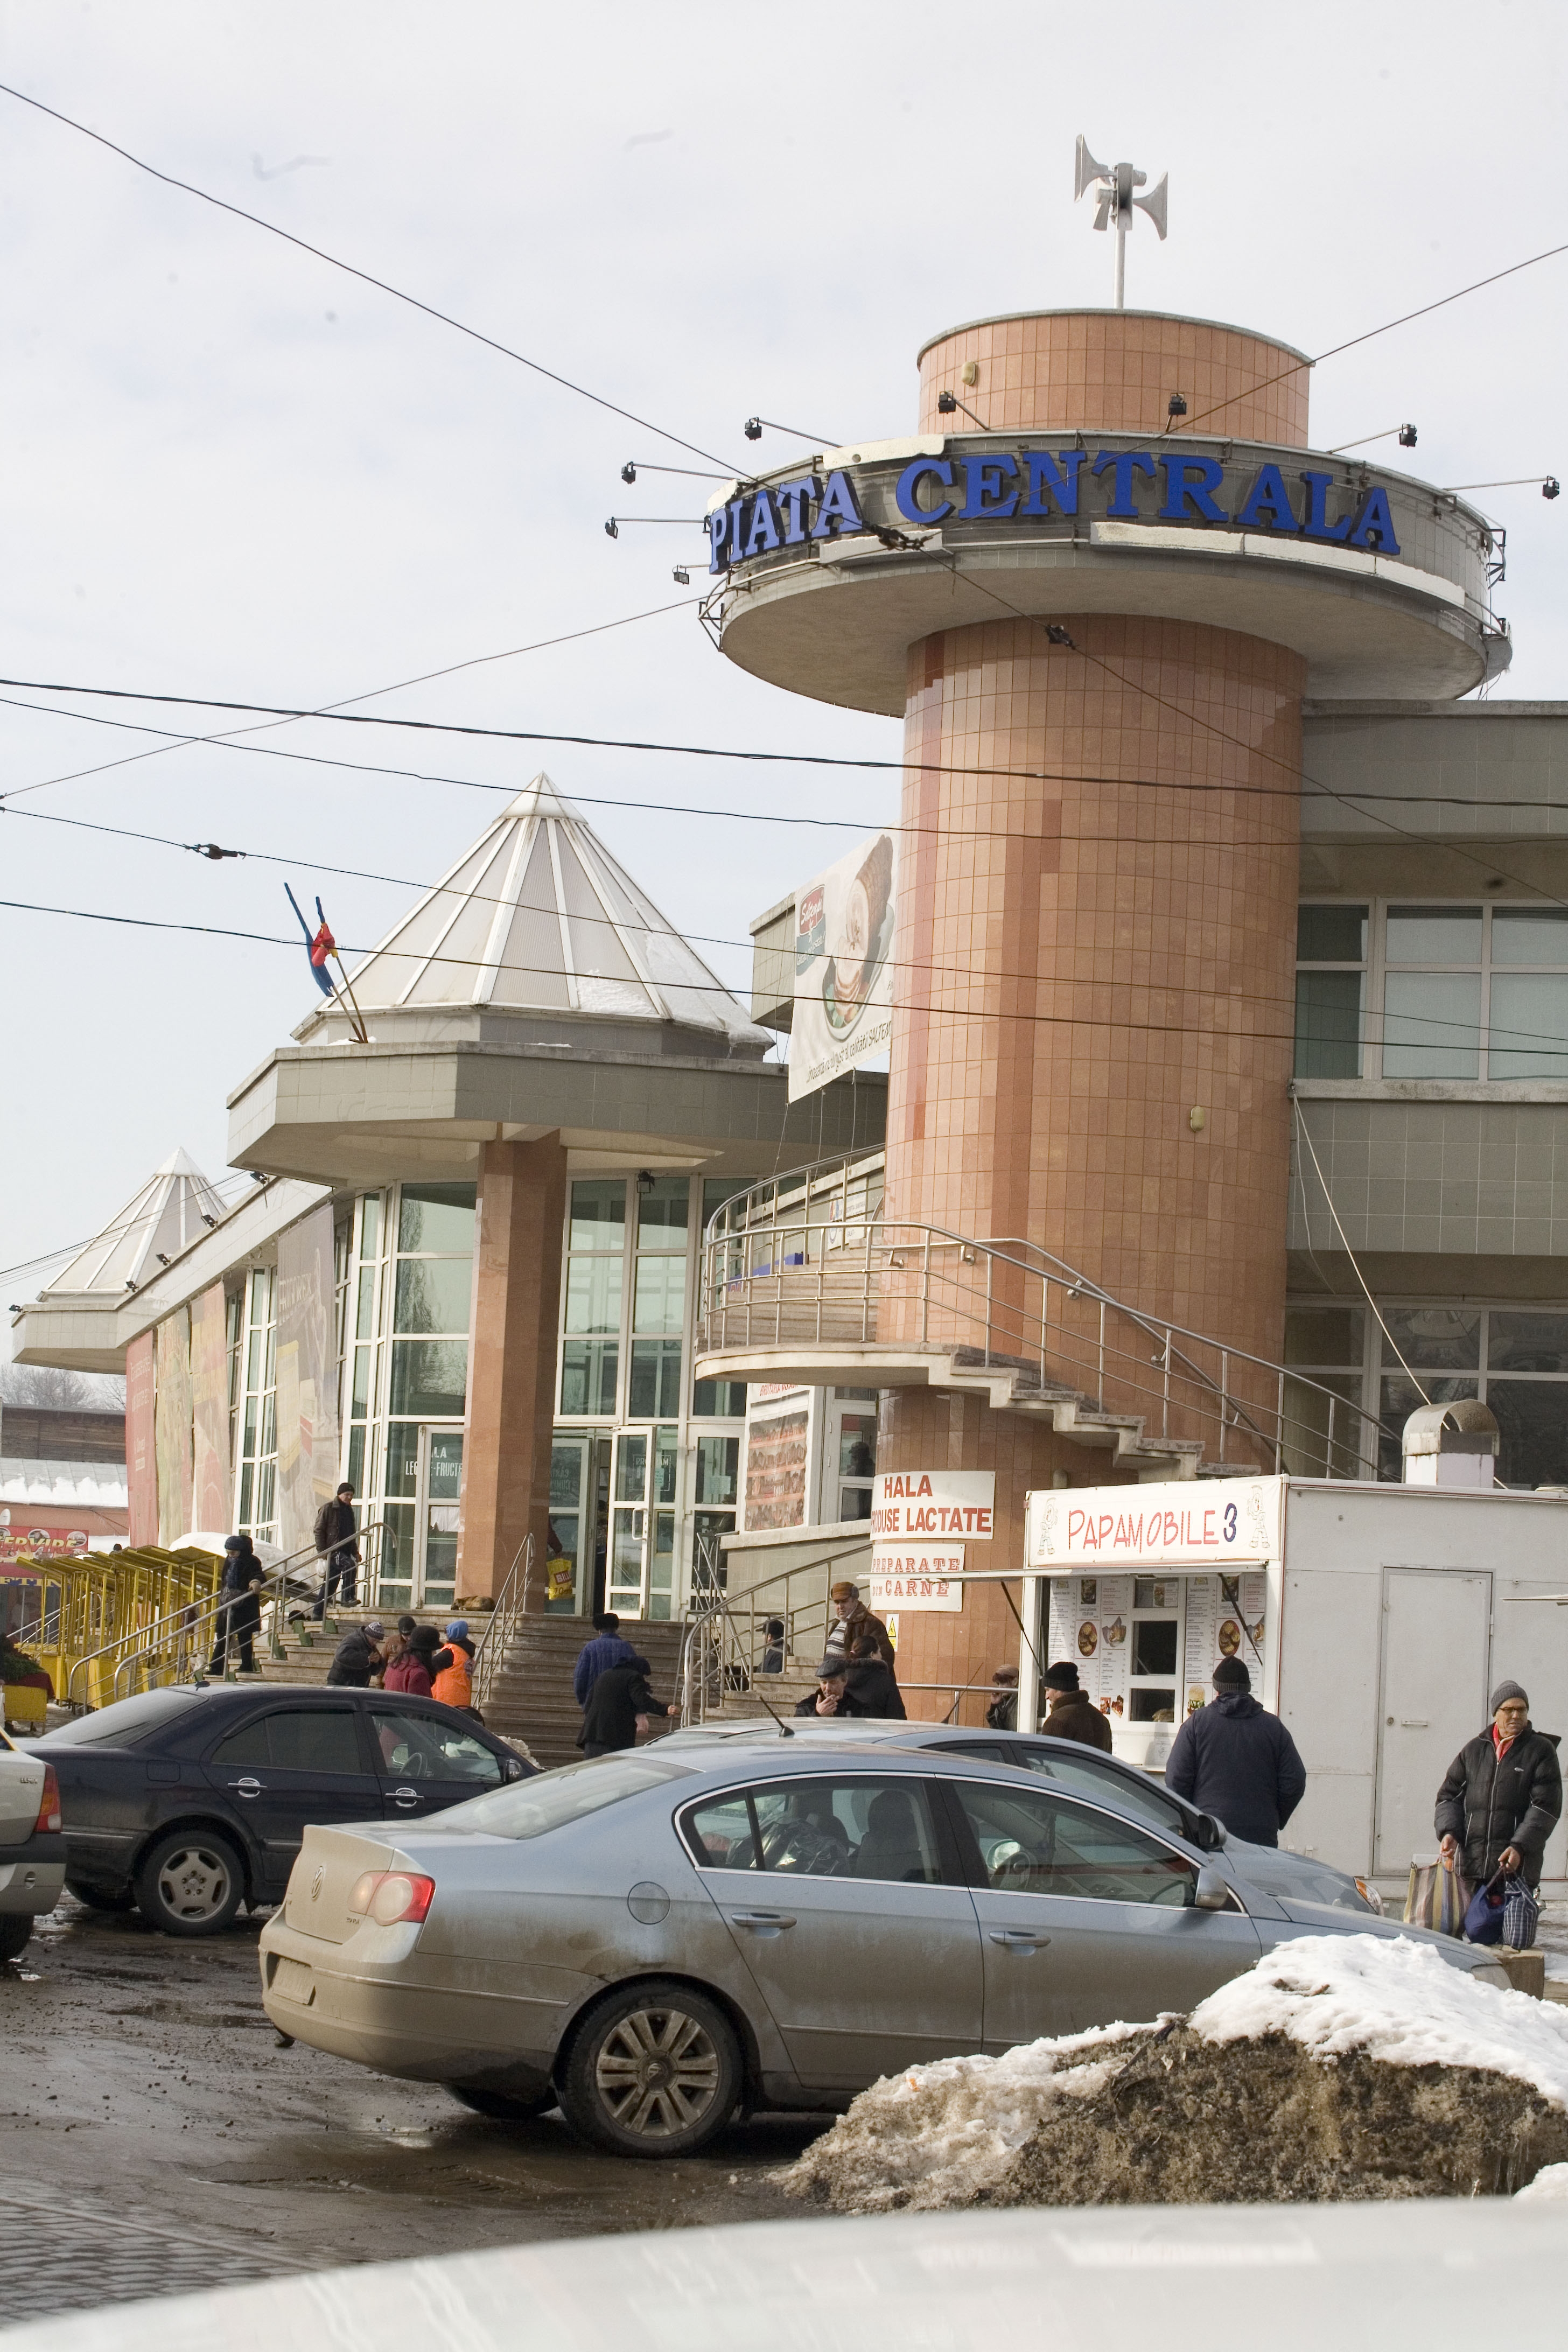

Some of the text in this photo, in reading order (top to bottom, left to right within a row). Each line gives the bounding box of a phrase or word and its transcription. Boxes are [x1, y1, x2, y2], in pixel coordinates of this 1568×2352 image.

[710, 451, 1401, 575] PIATA CENTRALA
[884, 1475, 933, 1499] HALA
[871, 1507, 991, 1534] PRODUSE LACTATE
[1068, 1503, 1237, 1553] PAPAMOBILE 3
[0, 1536, 77, 1555] ERVIRE
[872, 1558, 960, 1572] PREPARATE
[872, 1579, 949, 1597] DIN CARNE
